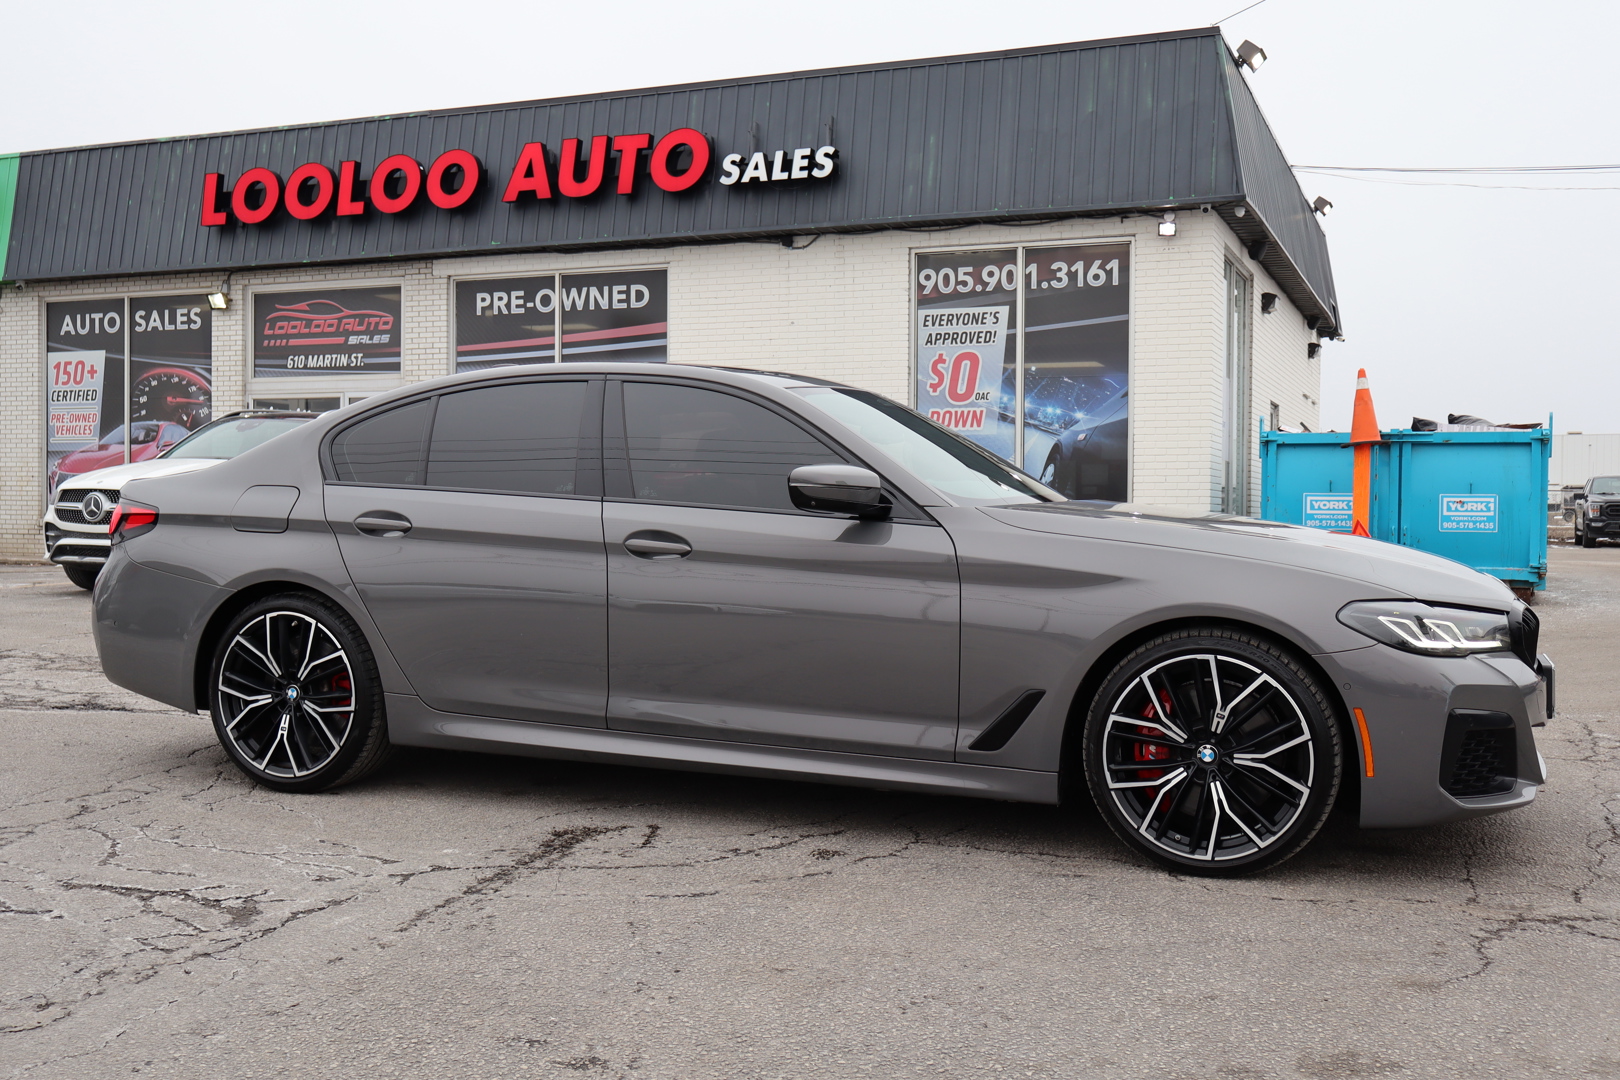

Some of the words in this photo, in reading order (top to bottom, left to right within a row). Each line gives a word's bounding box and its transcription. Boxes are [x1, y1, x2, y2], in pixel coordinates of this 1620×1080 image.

[201, 149, 480, 226] LOOLOO
[502, 128, 710, 202] AUTO
[719, 146, 836, 186] SALES
[918, 258, 1120, 295] 905.901.3161
[476, 284, 650, 316] PRE-OWNED
[60, 312, 121, 336] AUTO
[134, 307, 202, 333] SALES
[264, 319, 339, 335] LOOLOO
[339, 317, 394, 332] AUTO
[922, 311, 1000, 328] EVERYONE'S
[348, 334, 391, 345] SALES
[924, 330, 997, 346] APPROVED!
[287, 355, 305, 369] 610
[307, 354, 349, 368] MARTIN
[350, 353, 364, 366] ST.
[52, 360, 98, 386] 150+
[928, 351, 980, 403] $0
[51, 389, 98, 403] CERTIFIED
[974, 392, 991, 401] OAC
[50, 413, 98, 424] PRE-OWNED
[55, 424, 94, 436] VEHICLES
